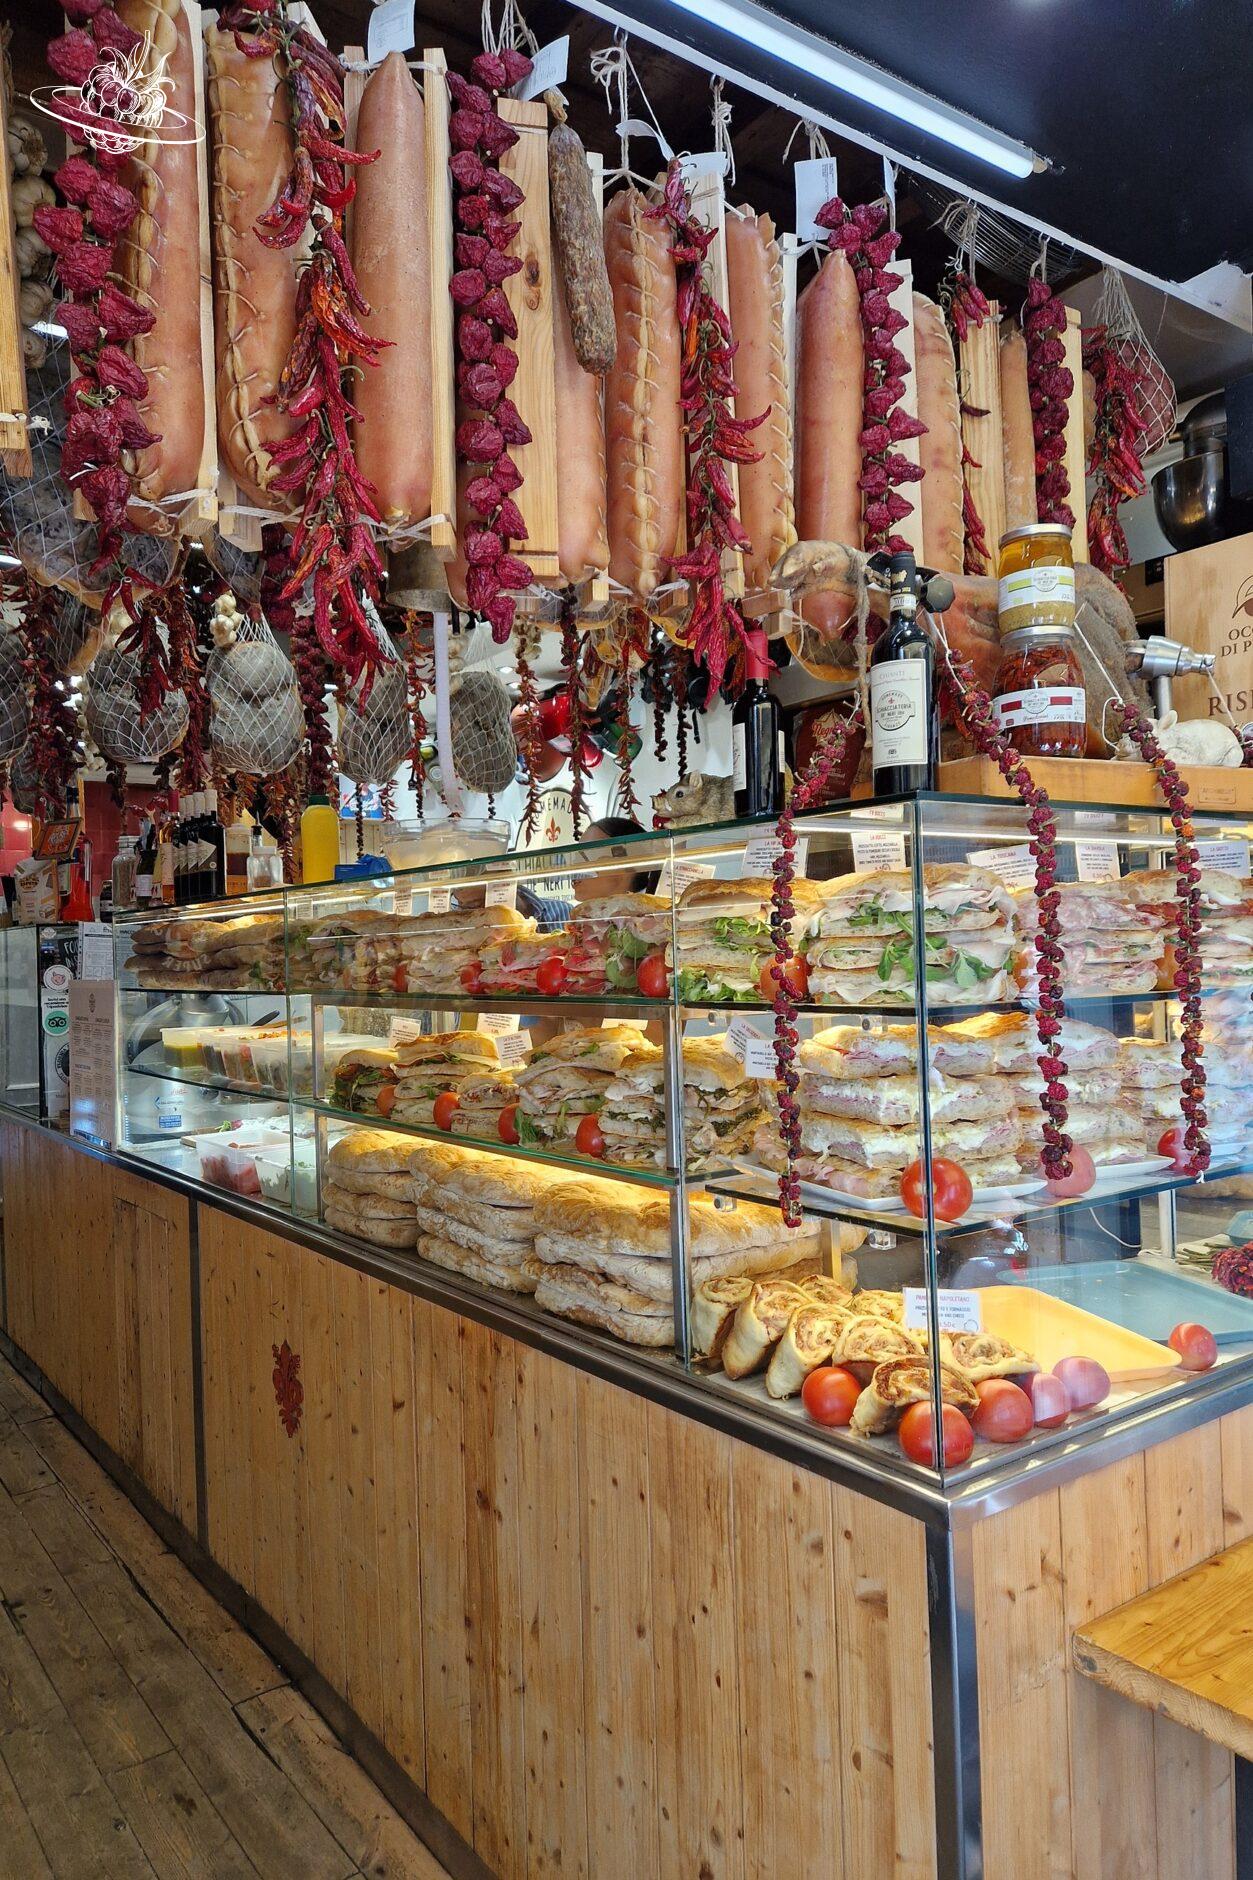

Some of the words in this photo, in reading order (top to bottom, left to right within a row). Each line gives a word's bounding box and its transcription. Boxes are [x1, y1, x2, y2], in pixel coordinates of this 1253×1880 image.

[1229, 625, 1253, 641] OC
[1221, 643, 1238, 657] DI
[1207, 689, 1253, 717] RIS
